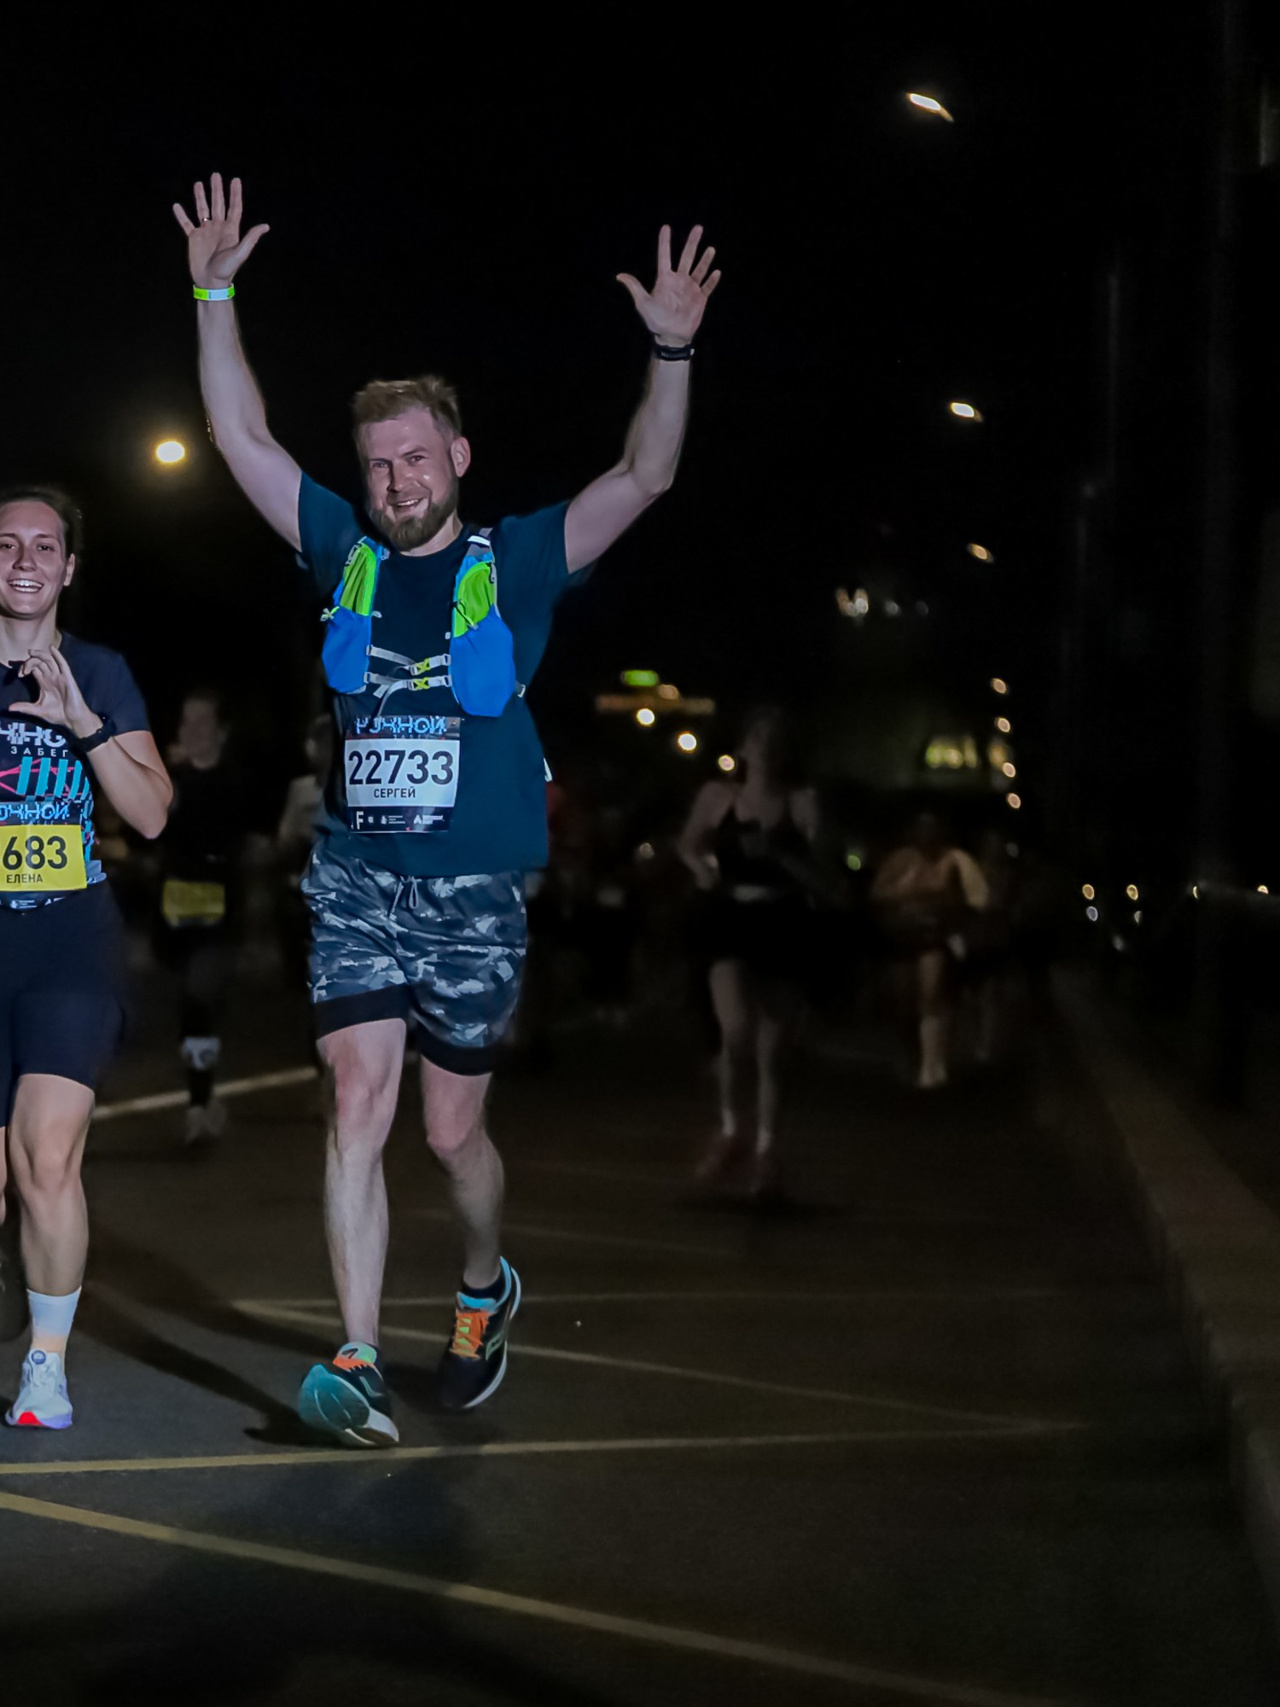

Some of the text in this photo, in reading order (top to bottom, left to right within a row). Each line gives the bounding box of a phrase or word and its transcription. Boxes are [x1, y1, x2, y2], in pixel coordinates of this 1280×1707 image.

[10, 745, 70, 758] ЗАБЕГ
[348, 749, 454, 785] 22733
[373, 785, 416, 799] СЕРГЕЙ
[356, 810, 365, 831] F
[6, 873, 44, 884] ЕЛЕНА
